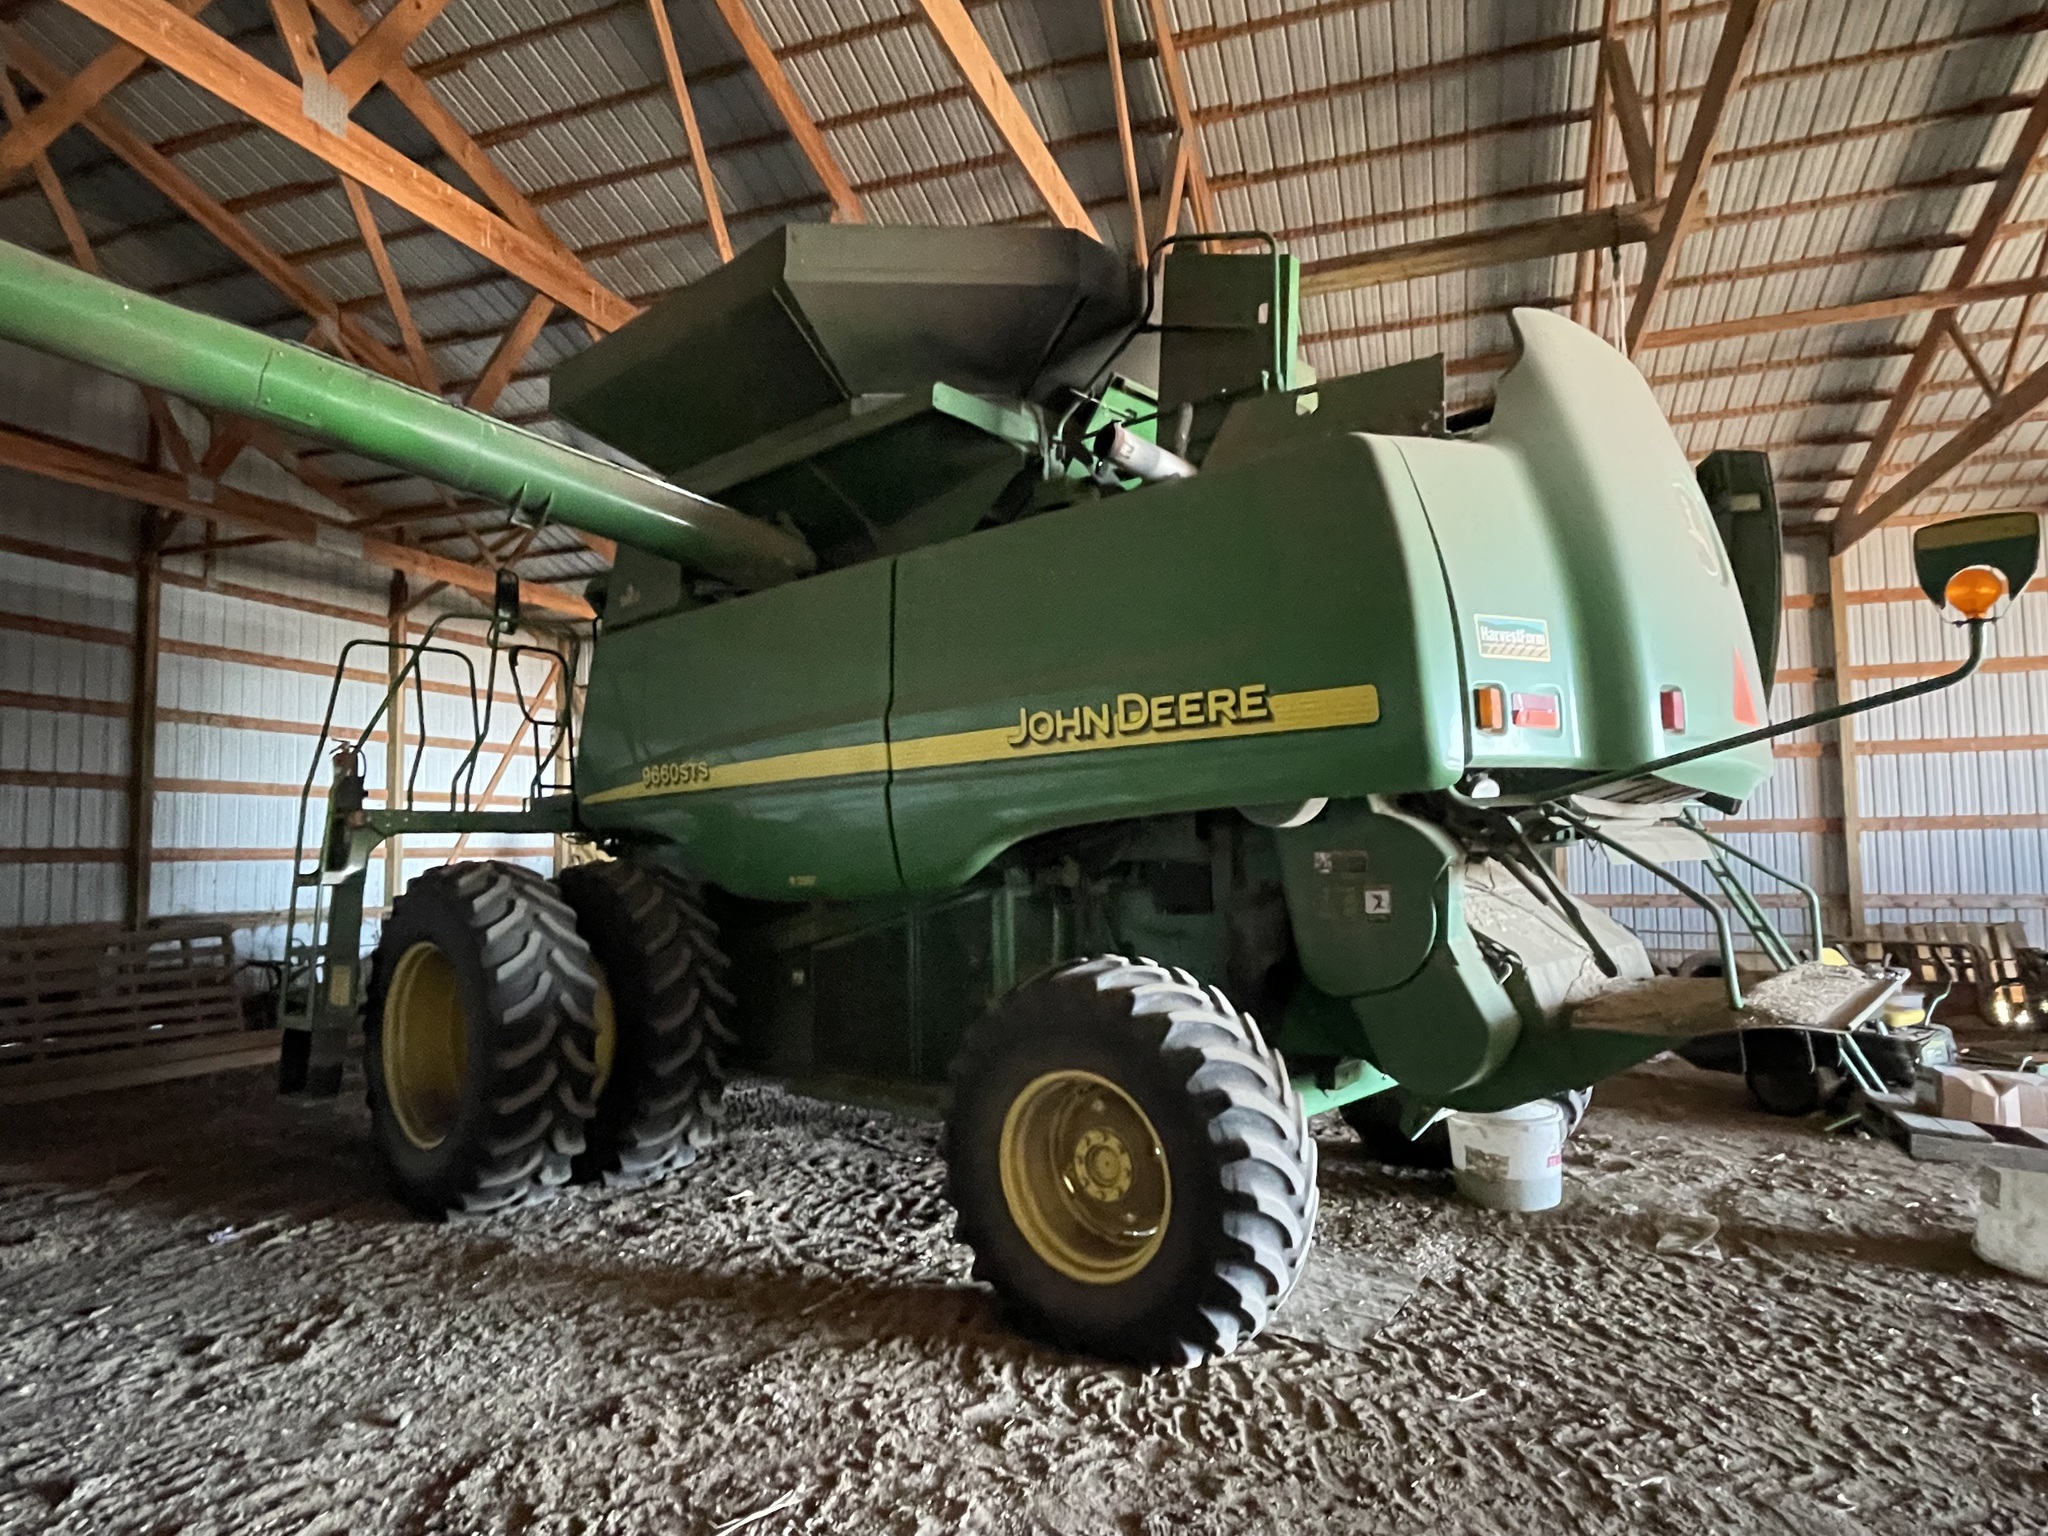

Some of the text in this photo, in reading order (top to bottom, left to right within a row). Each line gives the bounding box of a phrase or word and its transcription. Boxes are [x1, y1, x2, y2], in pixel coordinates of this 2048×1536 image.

[1008, 684, 1270, 745] JOHN DEERE
[642, 761, 709, 788] 9660STS
